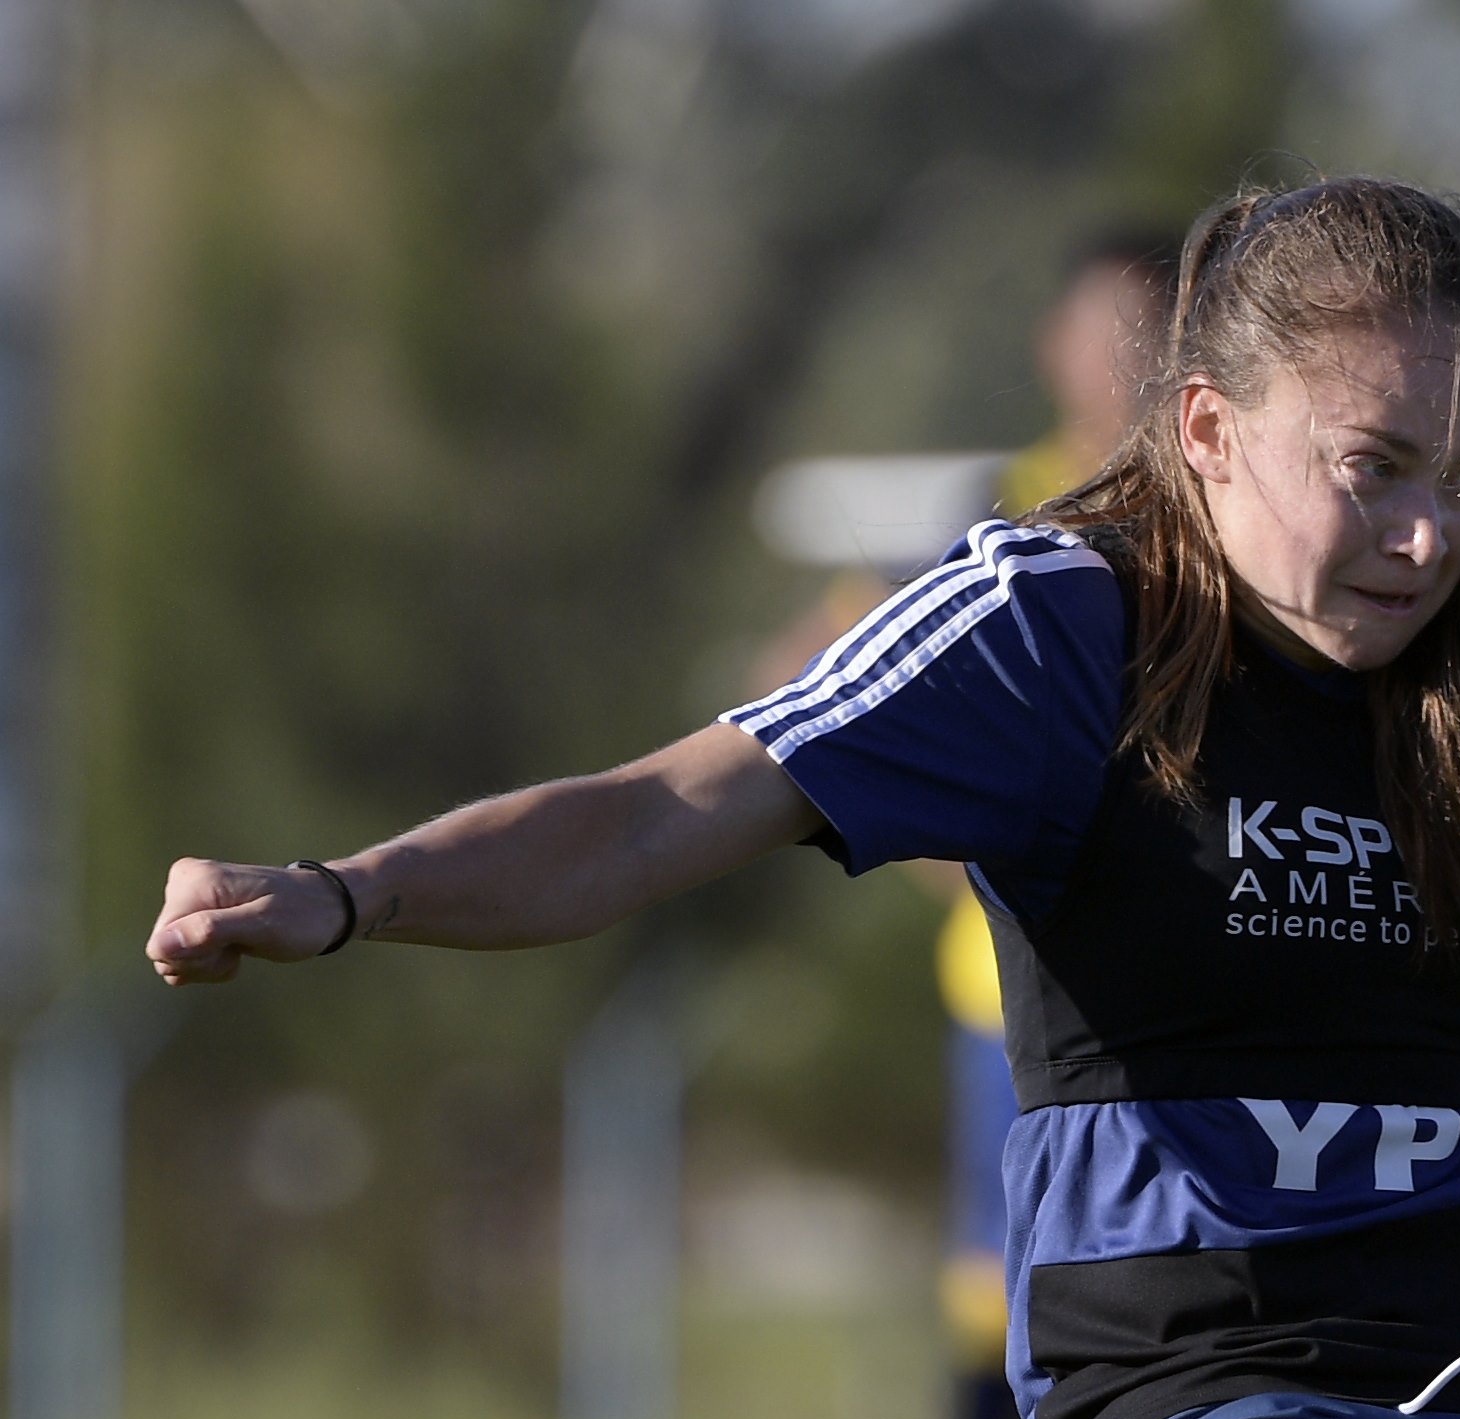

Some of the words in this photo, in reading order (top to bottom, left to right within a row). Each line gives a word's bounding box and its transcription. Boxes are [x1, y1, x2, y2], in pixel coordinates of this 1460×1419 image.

[1228, 797, 1405, 868] K-SP
[1229, 868, 1424, 914] AMÉR
[1226, 908, 1367, 942] science
[1379, 916, 1411, 944] to
